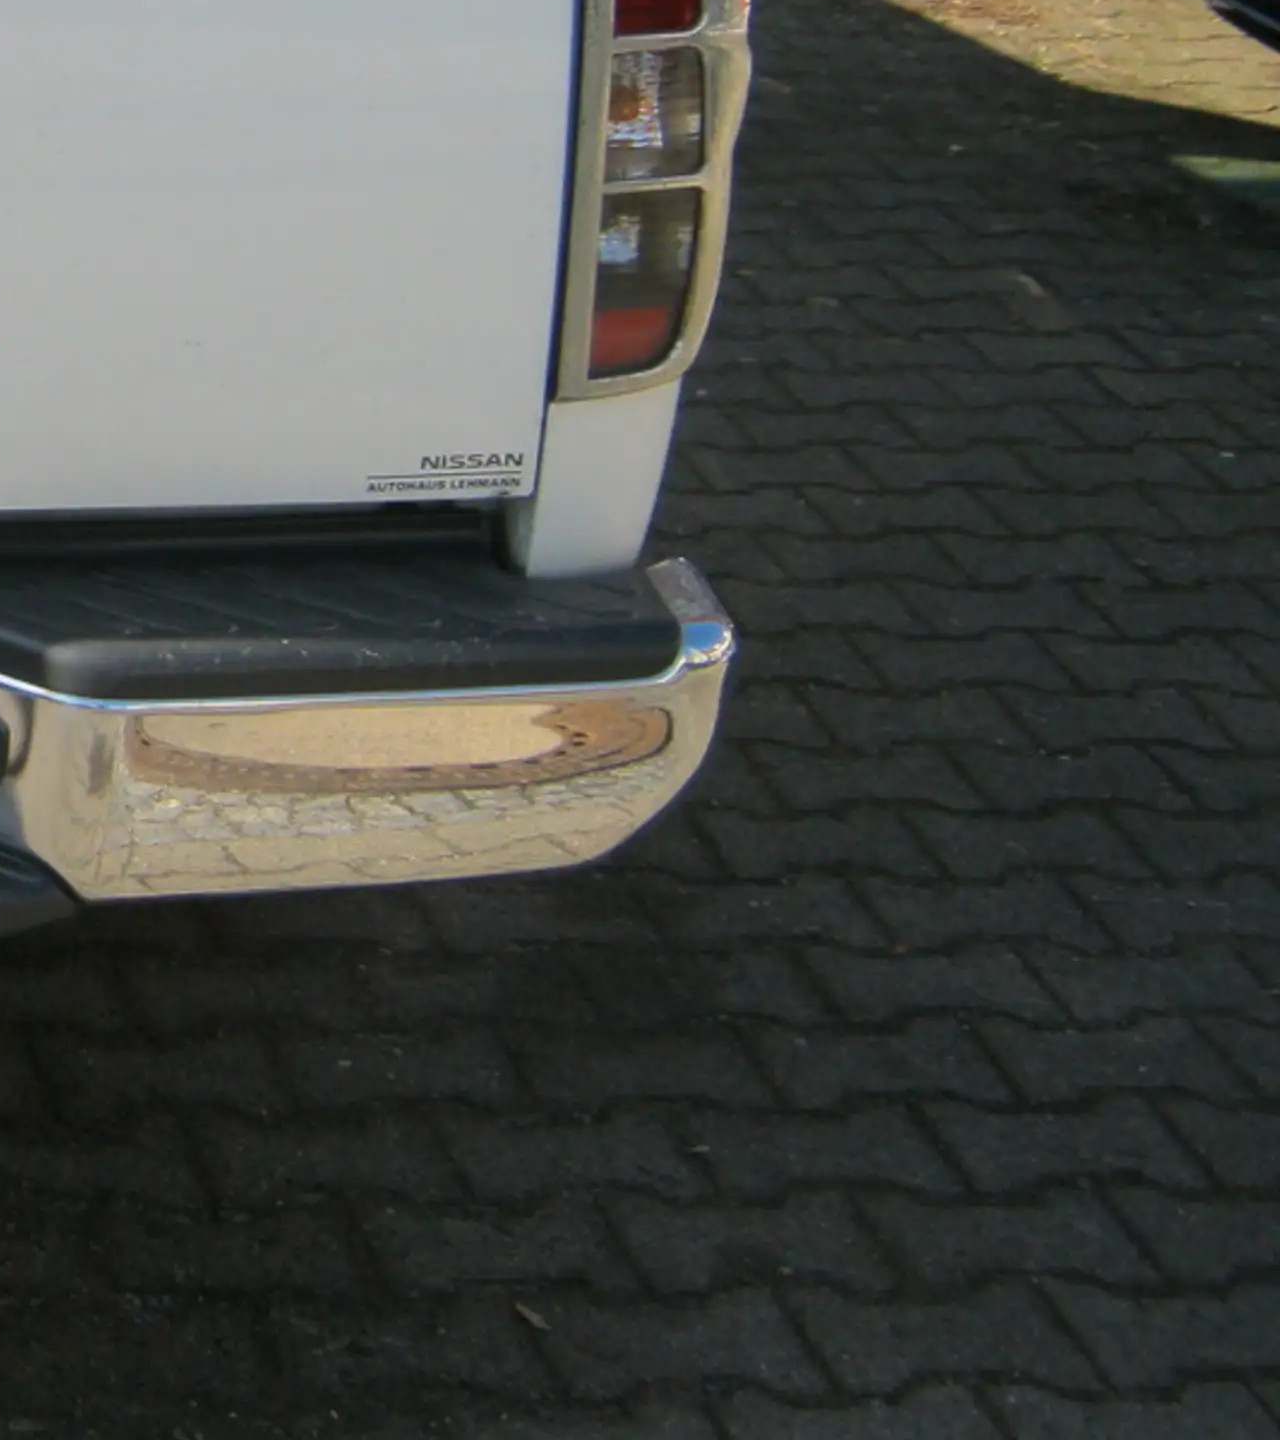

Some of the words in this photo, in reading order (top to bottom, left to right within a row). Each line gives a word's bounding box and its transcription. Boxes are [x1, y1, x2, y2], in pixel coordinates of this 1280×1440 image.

[420, 452, 524, 470] NISSAN
[366, 479, 446, 493] AUTOHAUS
[449, 477, 522, 490] LEHMANN
